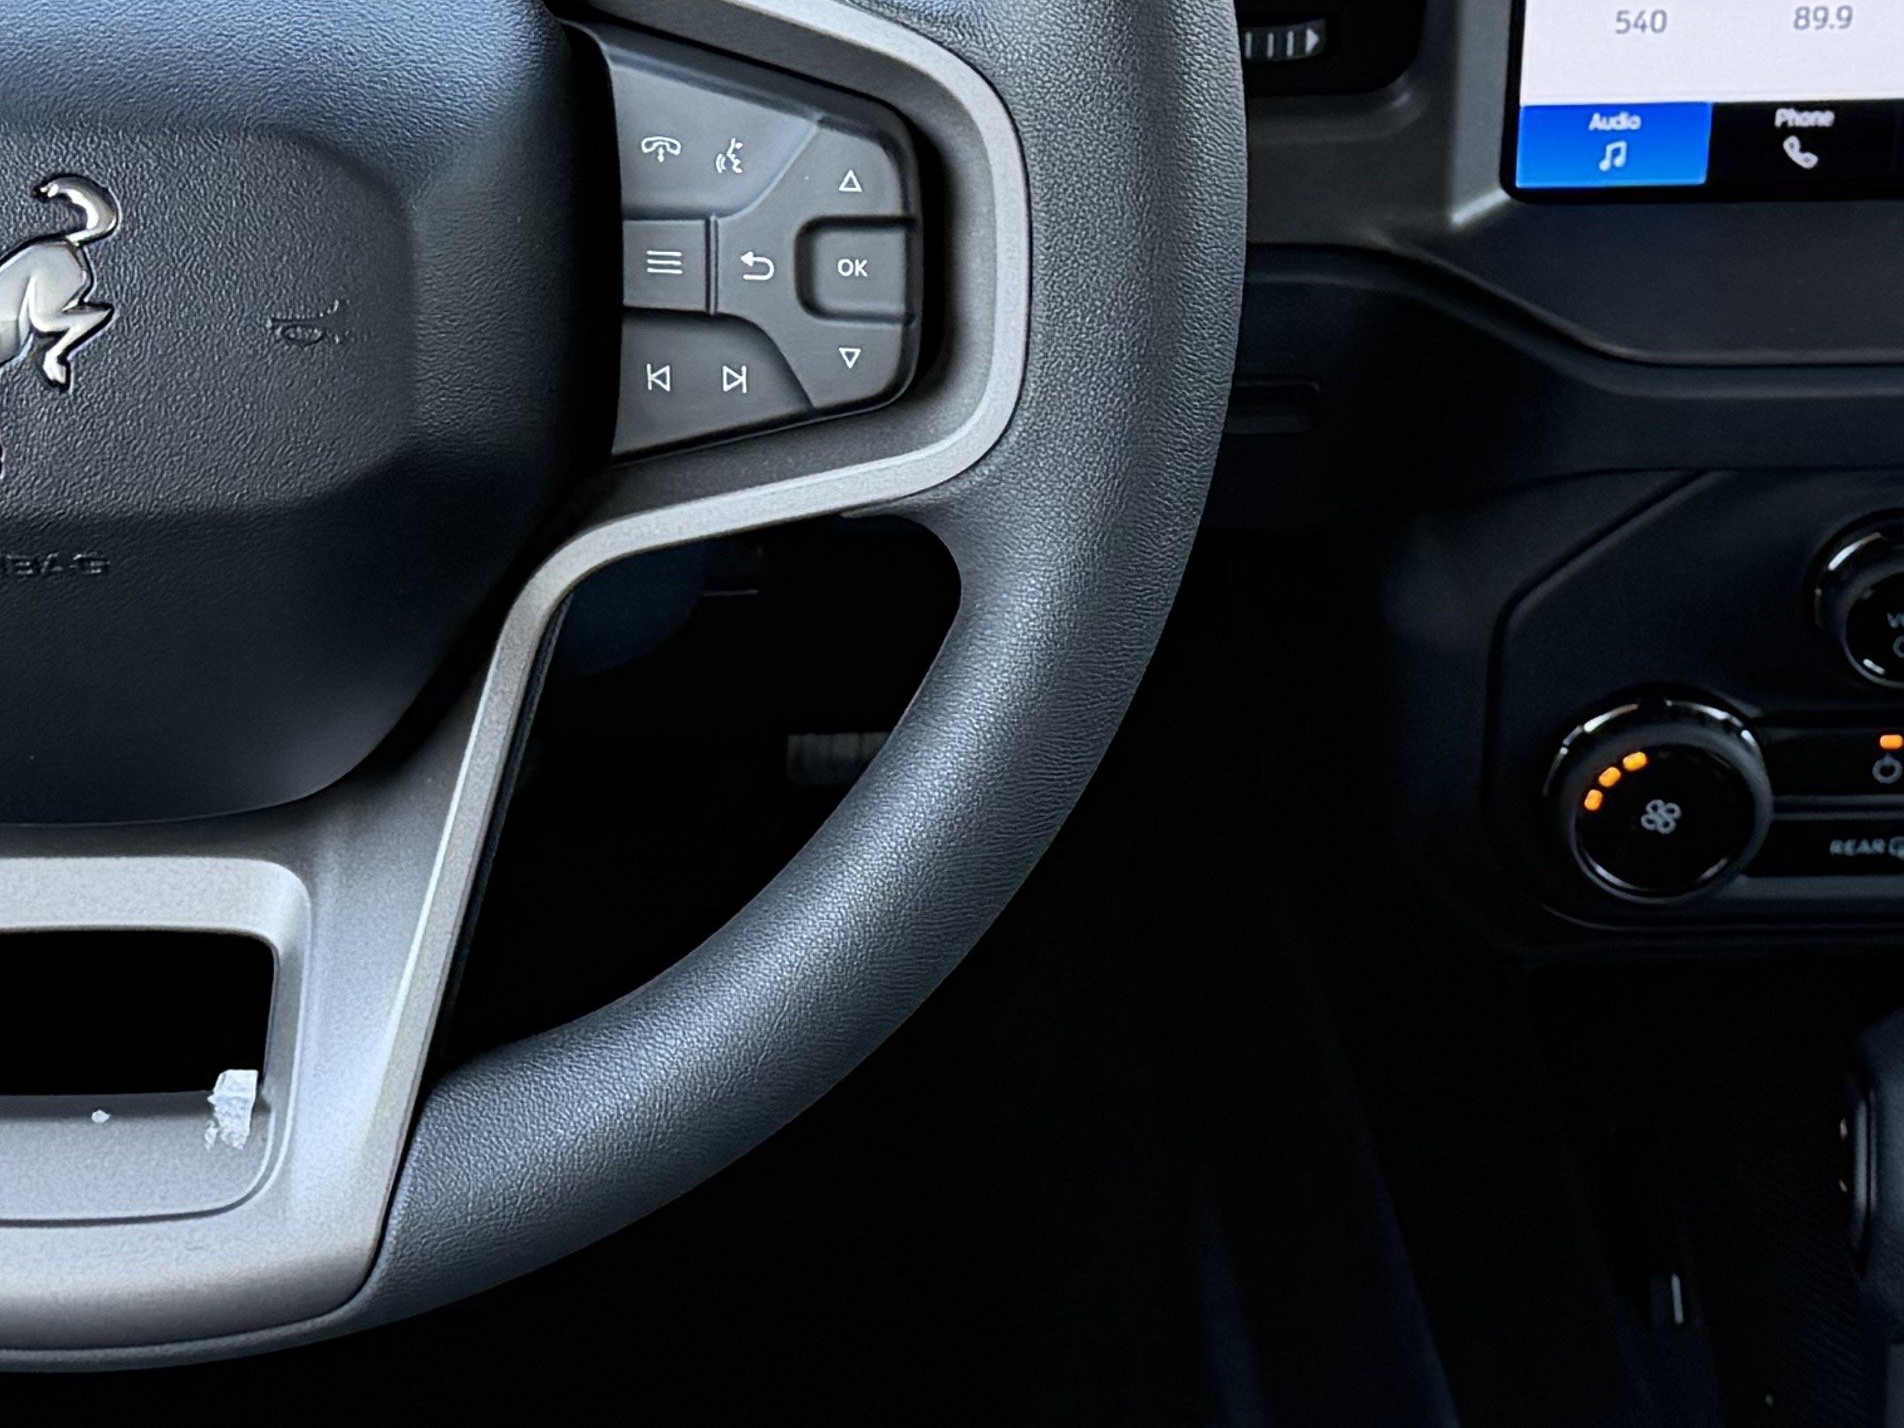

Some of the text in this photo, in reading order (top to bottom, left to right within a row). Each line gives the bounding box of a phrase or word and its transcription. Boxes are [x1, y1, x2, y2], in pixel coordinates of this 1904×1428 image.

[1614, 9, 1669, 35] 540
[1793, 4, 1854, 32] 89.9
[1587, 111, 1642, 133] Audio
[1774, 106, 1836, 129] Phone
[836, 258, 869, 279] OK
[1829, 837, 1886, 857] REAR
